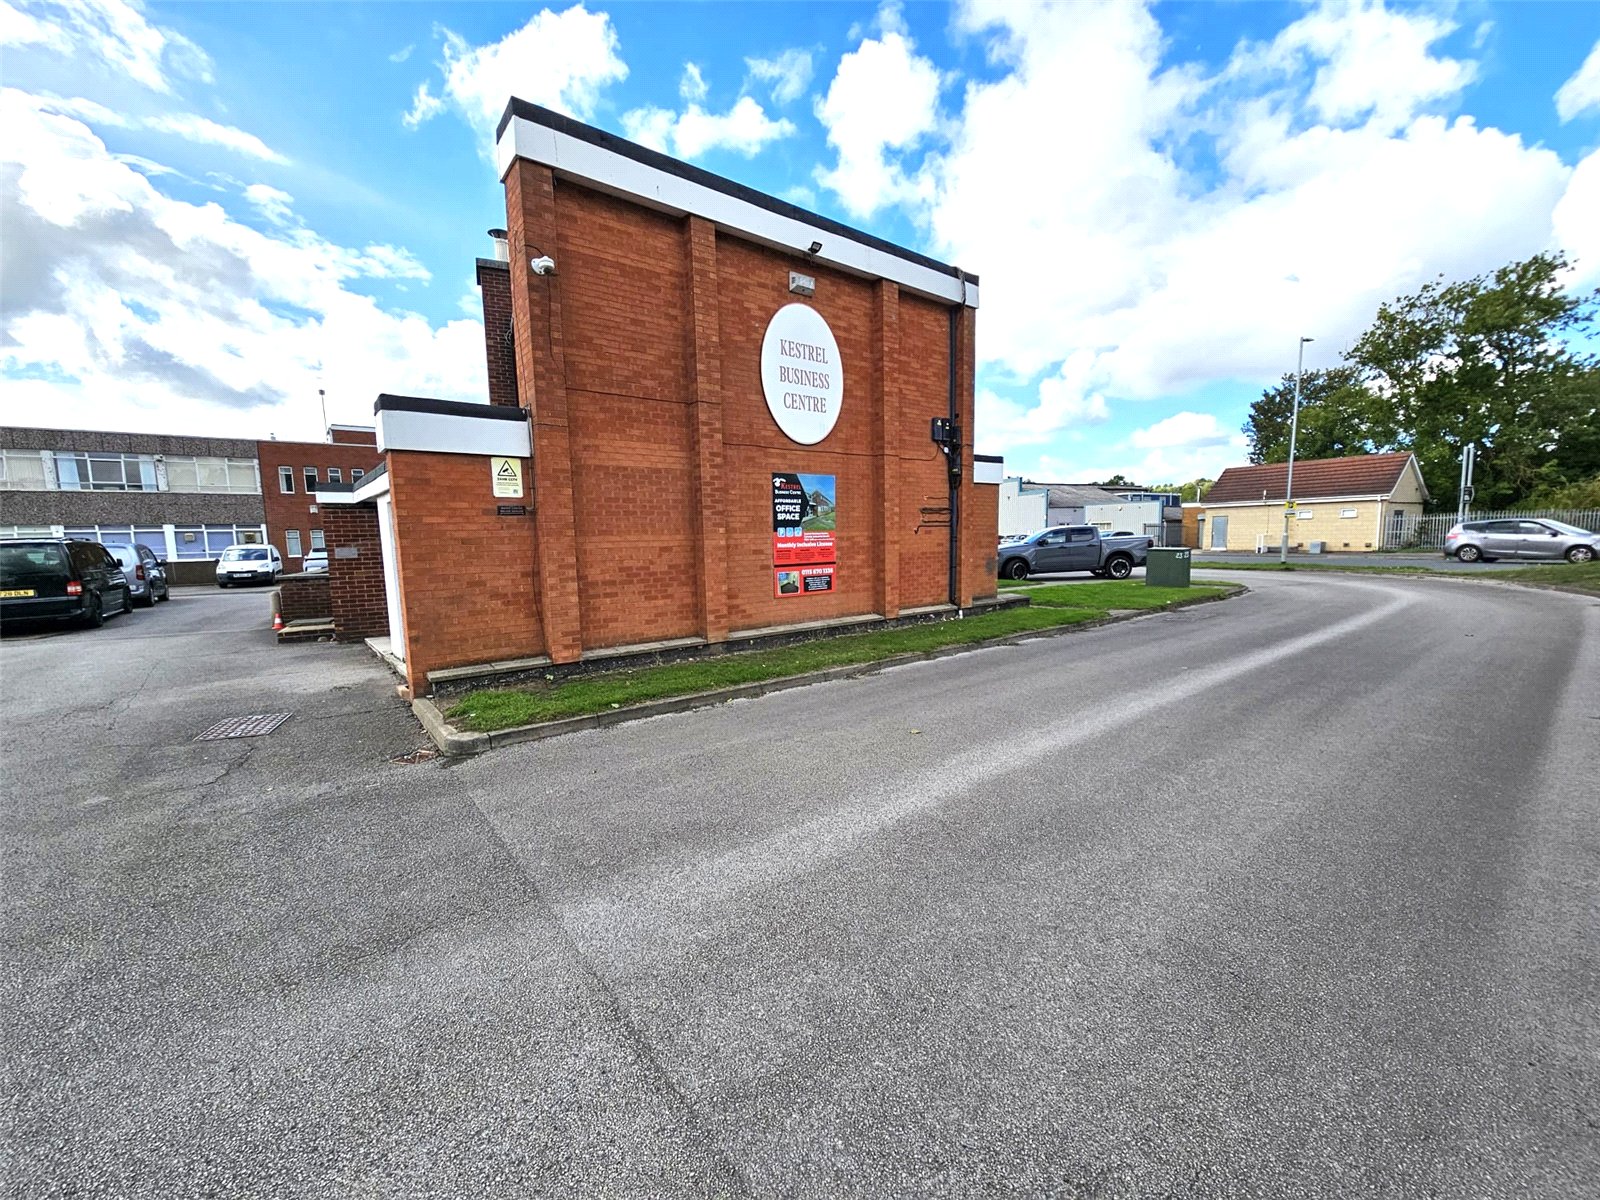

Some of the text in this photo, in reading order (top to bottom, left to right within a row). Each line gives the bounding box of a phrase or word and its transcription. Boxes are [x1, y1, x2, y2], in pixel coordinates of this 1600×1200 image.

[780, 339, 828, 364] KESTREL
[779, 366, 830, 390] BUSINESS
[783, 392, 827, 413] CENTRE
